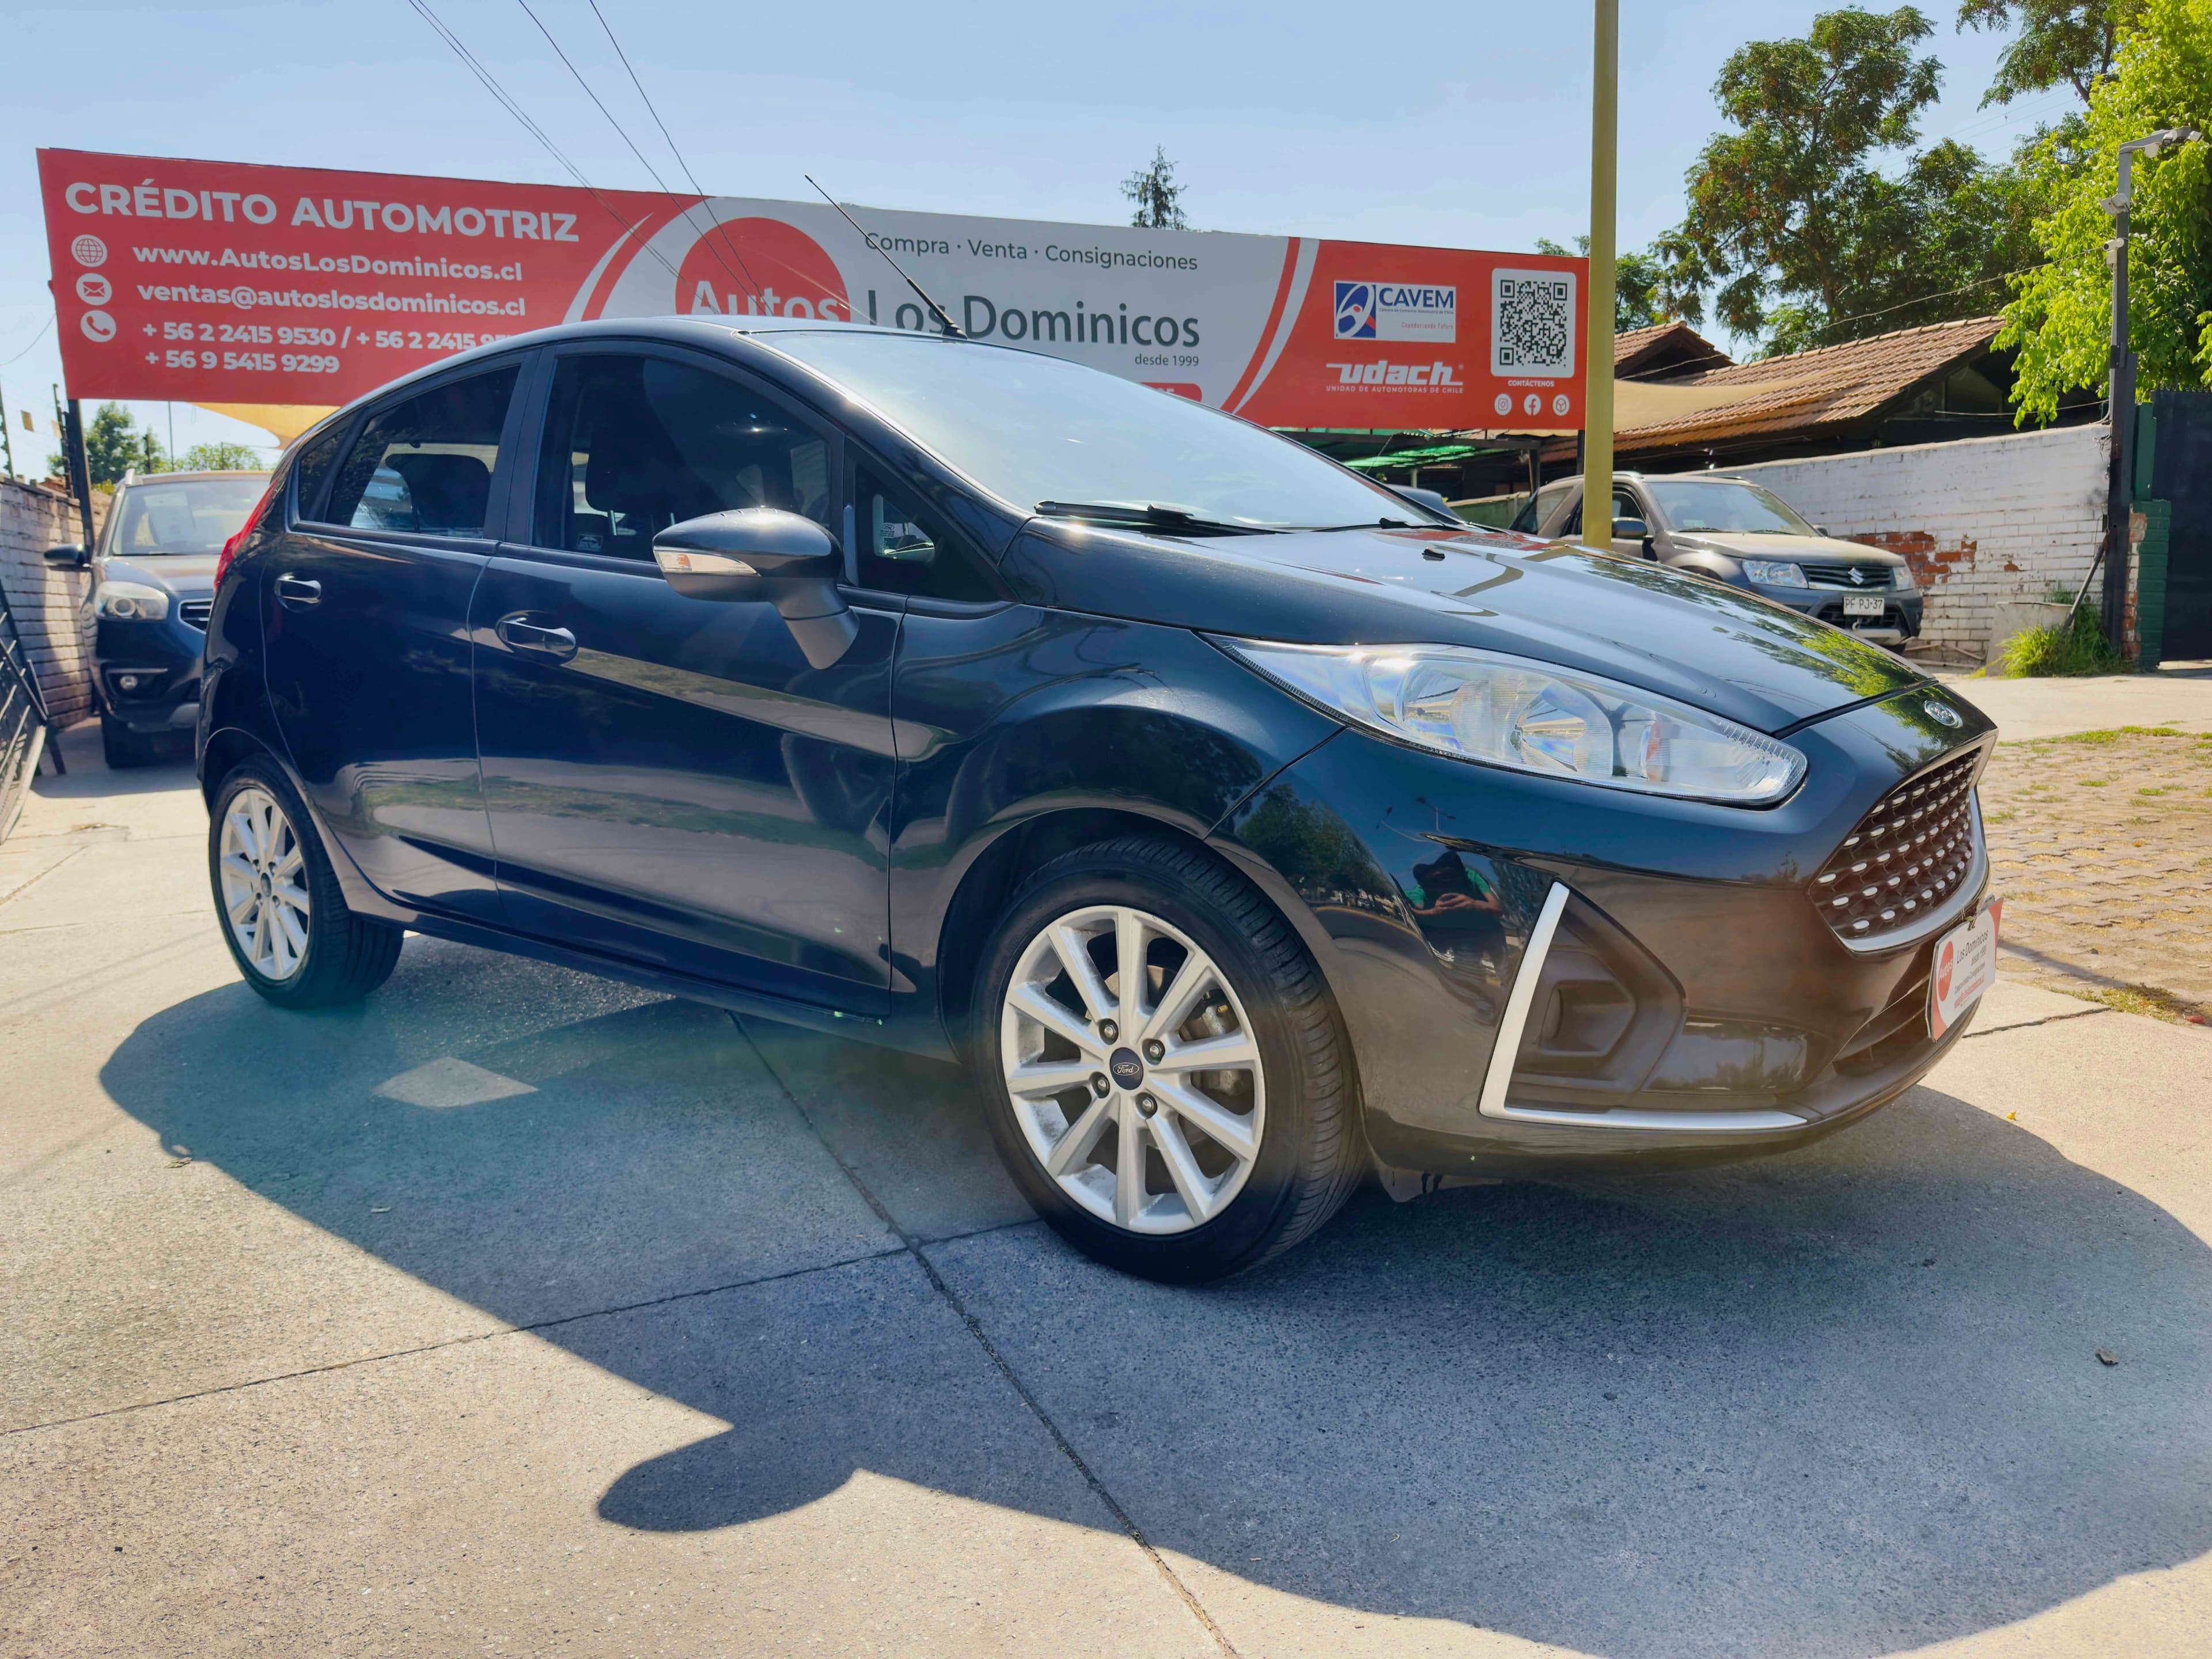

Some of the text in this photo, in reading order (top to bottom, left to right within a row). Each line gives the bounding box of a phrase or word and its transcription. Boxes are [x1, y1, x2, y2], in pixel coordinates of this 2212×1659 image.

[65, 179, 579, 242] CRÉDITO AUTOMOTRIZ
[132, 247, 522, 281] www.AutosLosDominicos.cl
[865, 232, 949, 256] Compra
[968, 239, 1027, 259] Venta
[1045, 245, 1198, 271] Consignaciones
[137, 285, 525, 316] ventas@autoslosdominicos.cl
[1379, 287, 1453, 309] CAVEM
[691, 281, 839, 321] Autos
[964, 294, 1200, 347] Dominicos
[164, 321, 194, 340] 56
[198, 323, 215, 341] 2
[218, 324, 273, 344] 2415
[277, 327, 336, 345] 9530
[376, 331, 404, 349] 56
[407, 332, 422, 349] 2
[427, 332, 476, 350] 2415
[165, 350, 196, 369] 56
[201, 351, 217, 369] 9
[223, 352, 277, 371] 5415
[281, 354, 340, 373] 9299
[1135, 353, 1199, 366] desde 1999
[1508, 379, 1554, 387] CONTÁCTENOS
[1117, 1065, 1134, 1074] Ford
